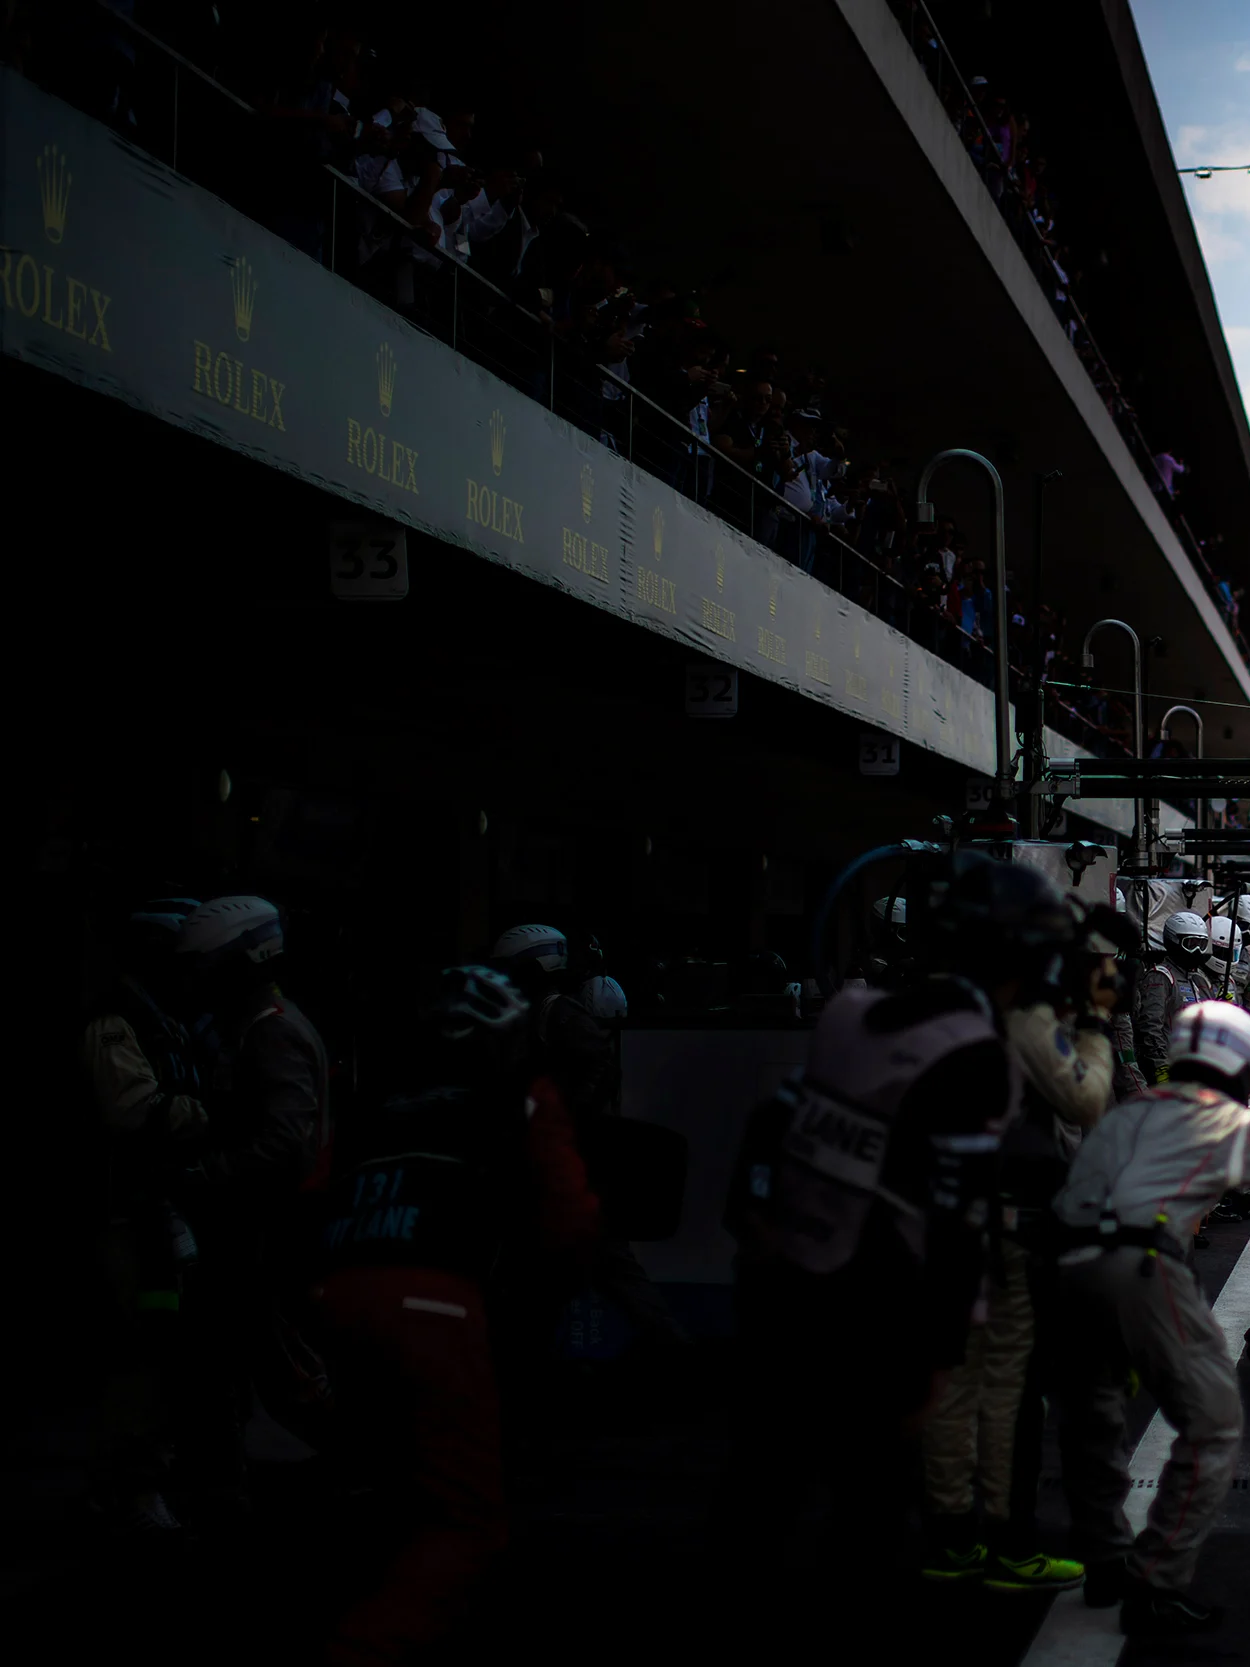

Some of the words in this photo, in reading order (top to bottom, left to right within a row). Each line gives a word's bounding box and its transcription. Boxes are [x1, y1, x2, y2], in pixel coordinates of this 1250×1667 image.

[191, 339, 286, 431] ROLEX
[346, 417, 419, 495] ROLEX
[465, 478, 525, 544] ROLEX
[334, 538, 398, 580] 33
[637, 566, 677, 615] ROLEX
[690, 674, 733, 702] 32
[861, 743, 896, 763] 31
[969, 786, 994, 802] 30
